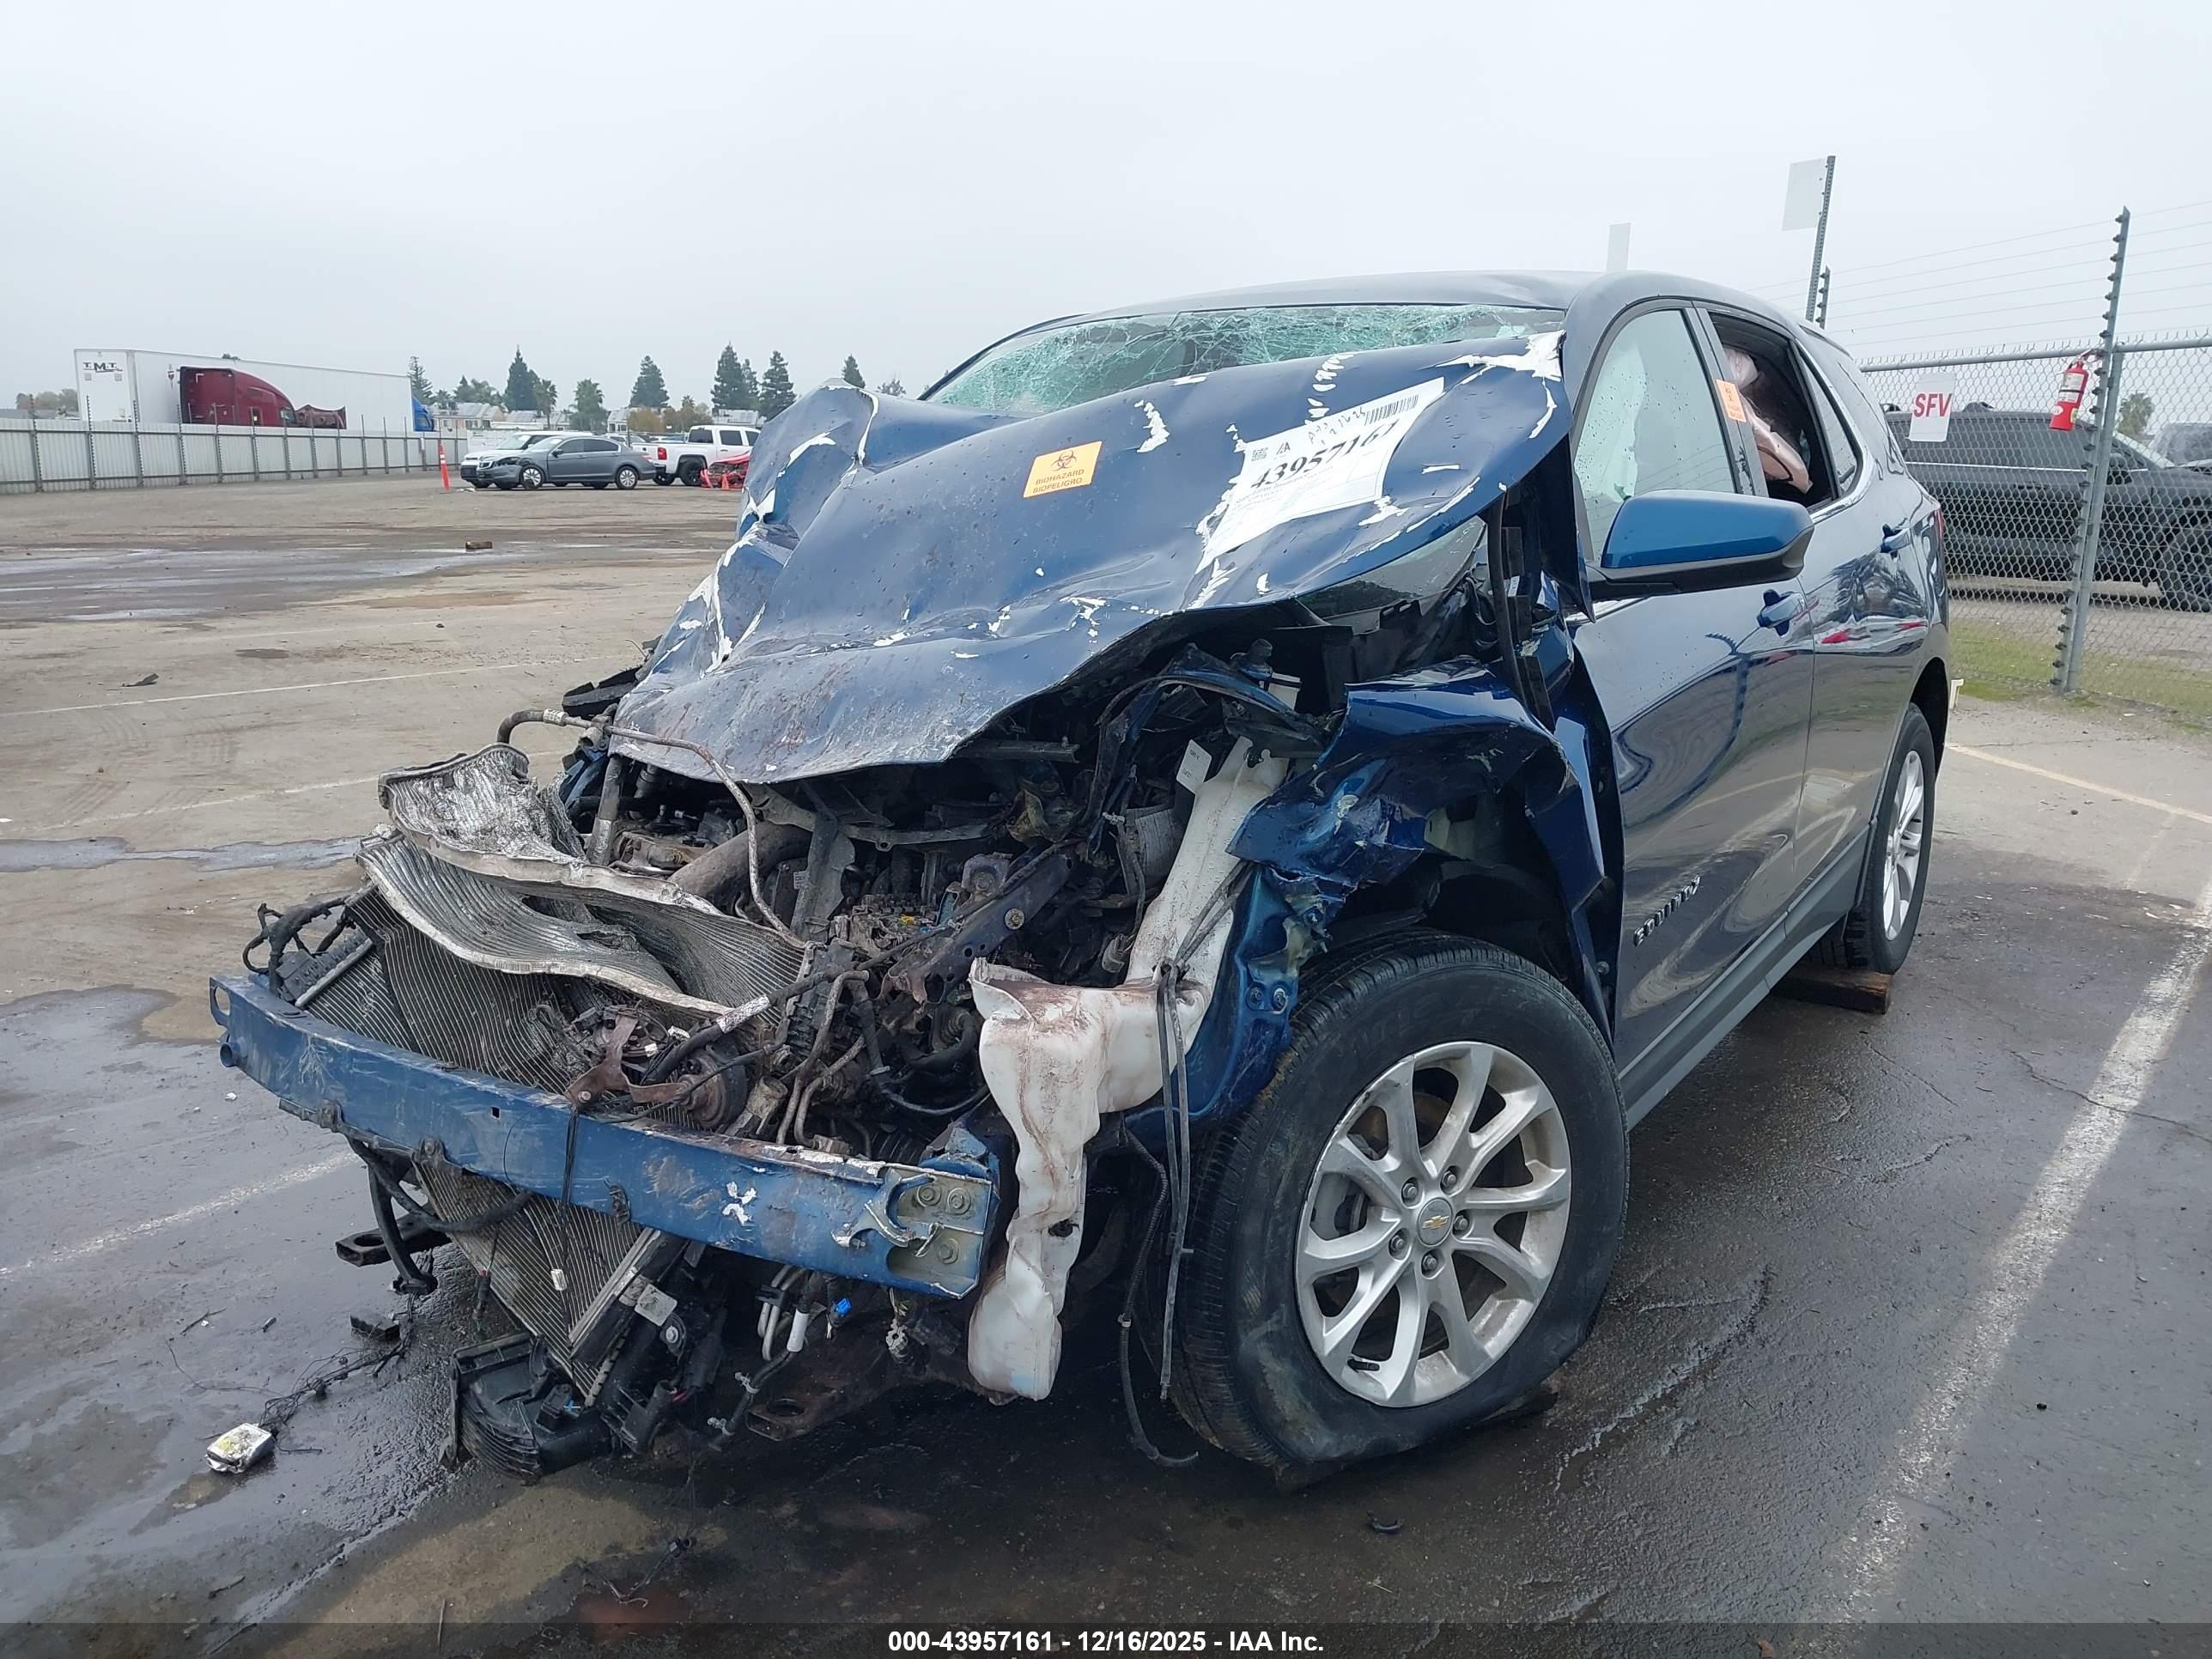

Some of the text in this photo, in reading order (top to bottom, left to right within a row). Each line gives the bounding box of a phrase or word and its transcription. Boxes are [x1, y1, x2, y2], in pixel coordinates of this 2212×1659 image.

[1913, 392, 1953, 417] SFV
[1032, 477, 1083, 494] BIOPELIGRO
[1035, 469, 1085, 486] BIOHAZARD
